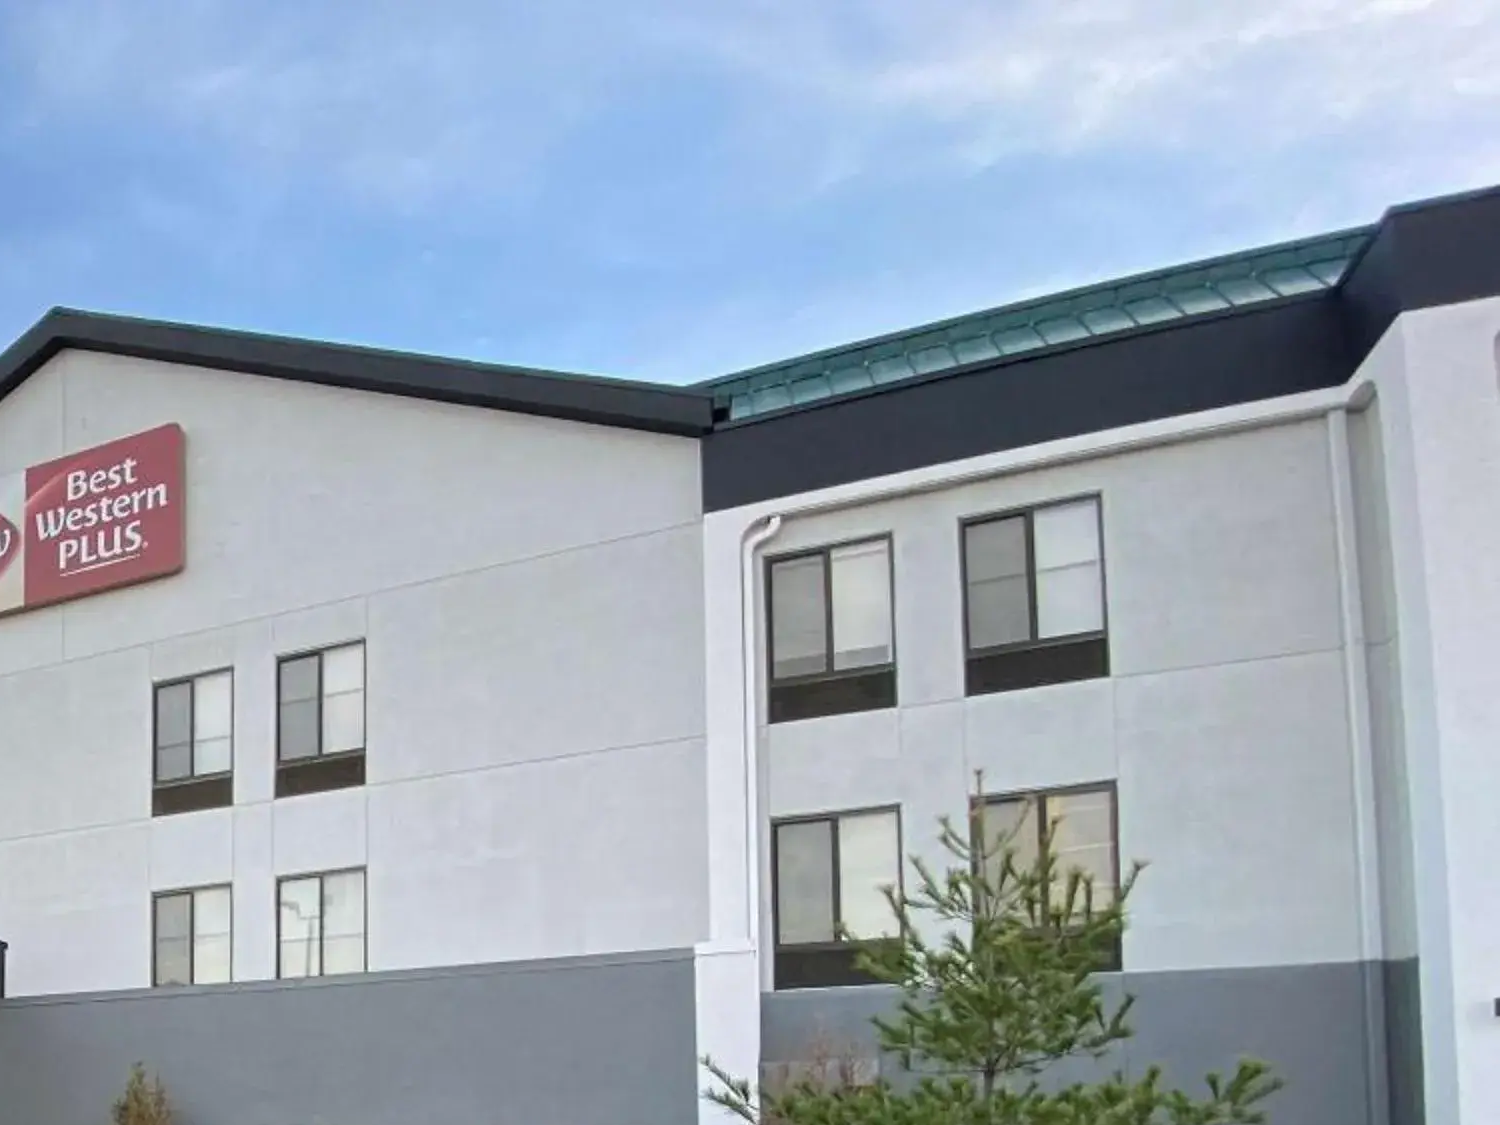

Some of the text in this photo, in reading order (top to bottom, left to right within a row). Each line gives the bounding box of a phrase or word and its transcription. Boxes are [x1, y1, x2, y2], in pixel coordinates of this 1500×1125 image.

[66, 457, 138, 501] Best
[35, 482, 168, 541] Western
[58, 519, 142, 570] PLUS
